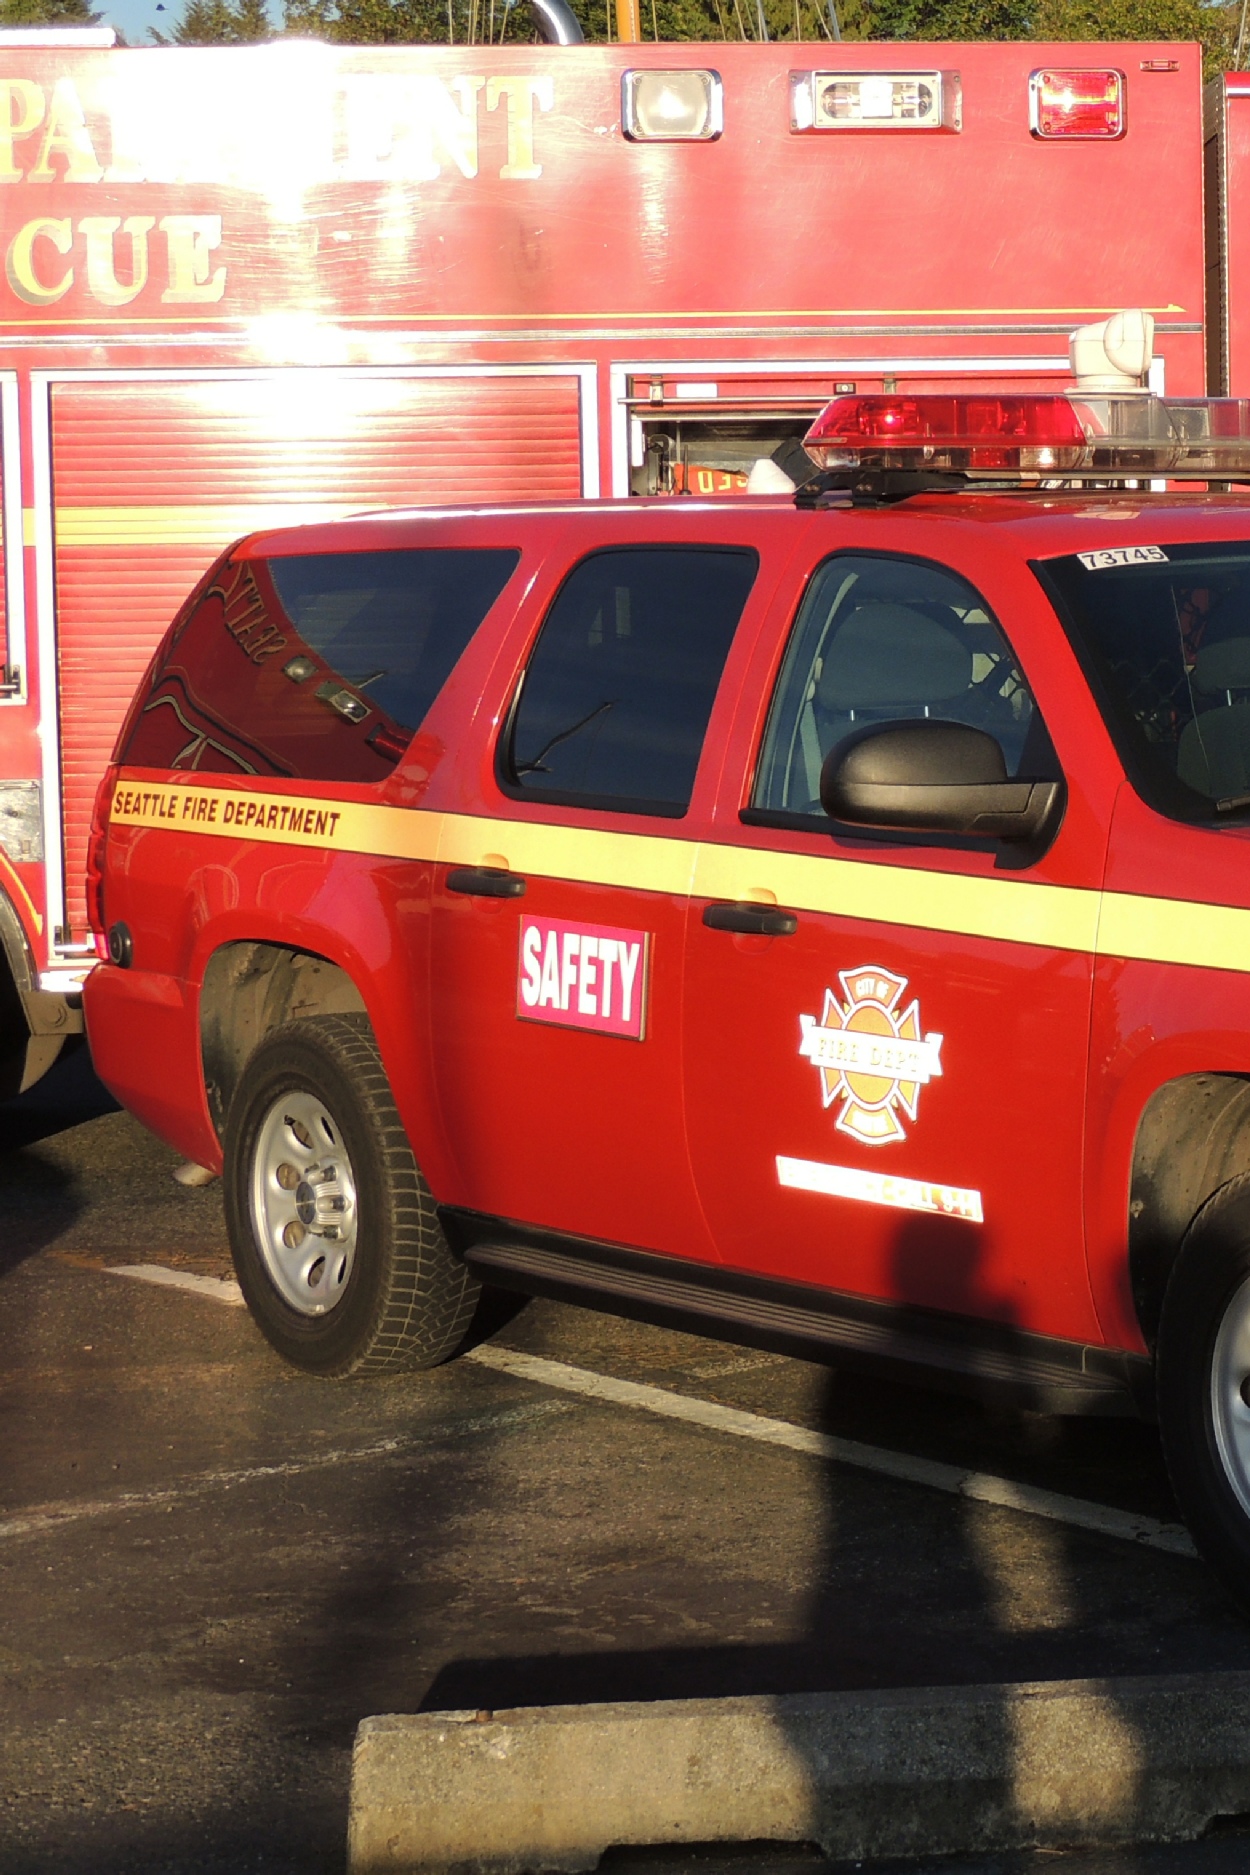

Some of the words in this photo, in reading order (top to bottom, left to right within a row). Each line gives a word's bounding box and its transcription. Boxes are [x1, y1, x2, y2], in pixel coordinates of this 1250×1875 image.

[5, 215, 227, 306] CUE
[1081, 547, 1165, 568] 73745
[114, 791, 178, 819] SEATTLE
[182, 797, 219, 822] FIRE
[223, 800, 341, 837] DEPARTMENT
[521, 925, 640, 1022] SAFETY
[818, 1037, 859, 1063] FIRE
